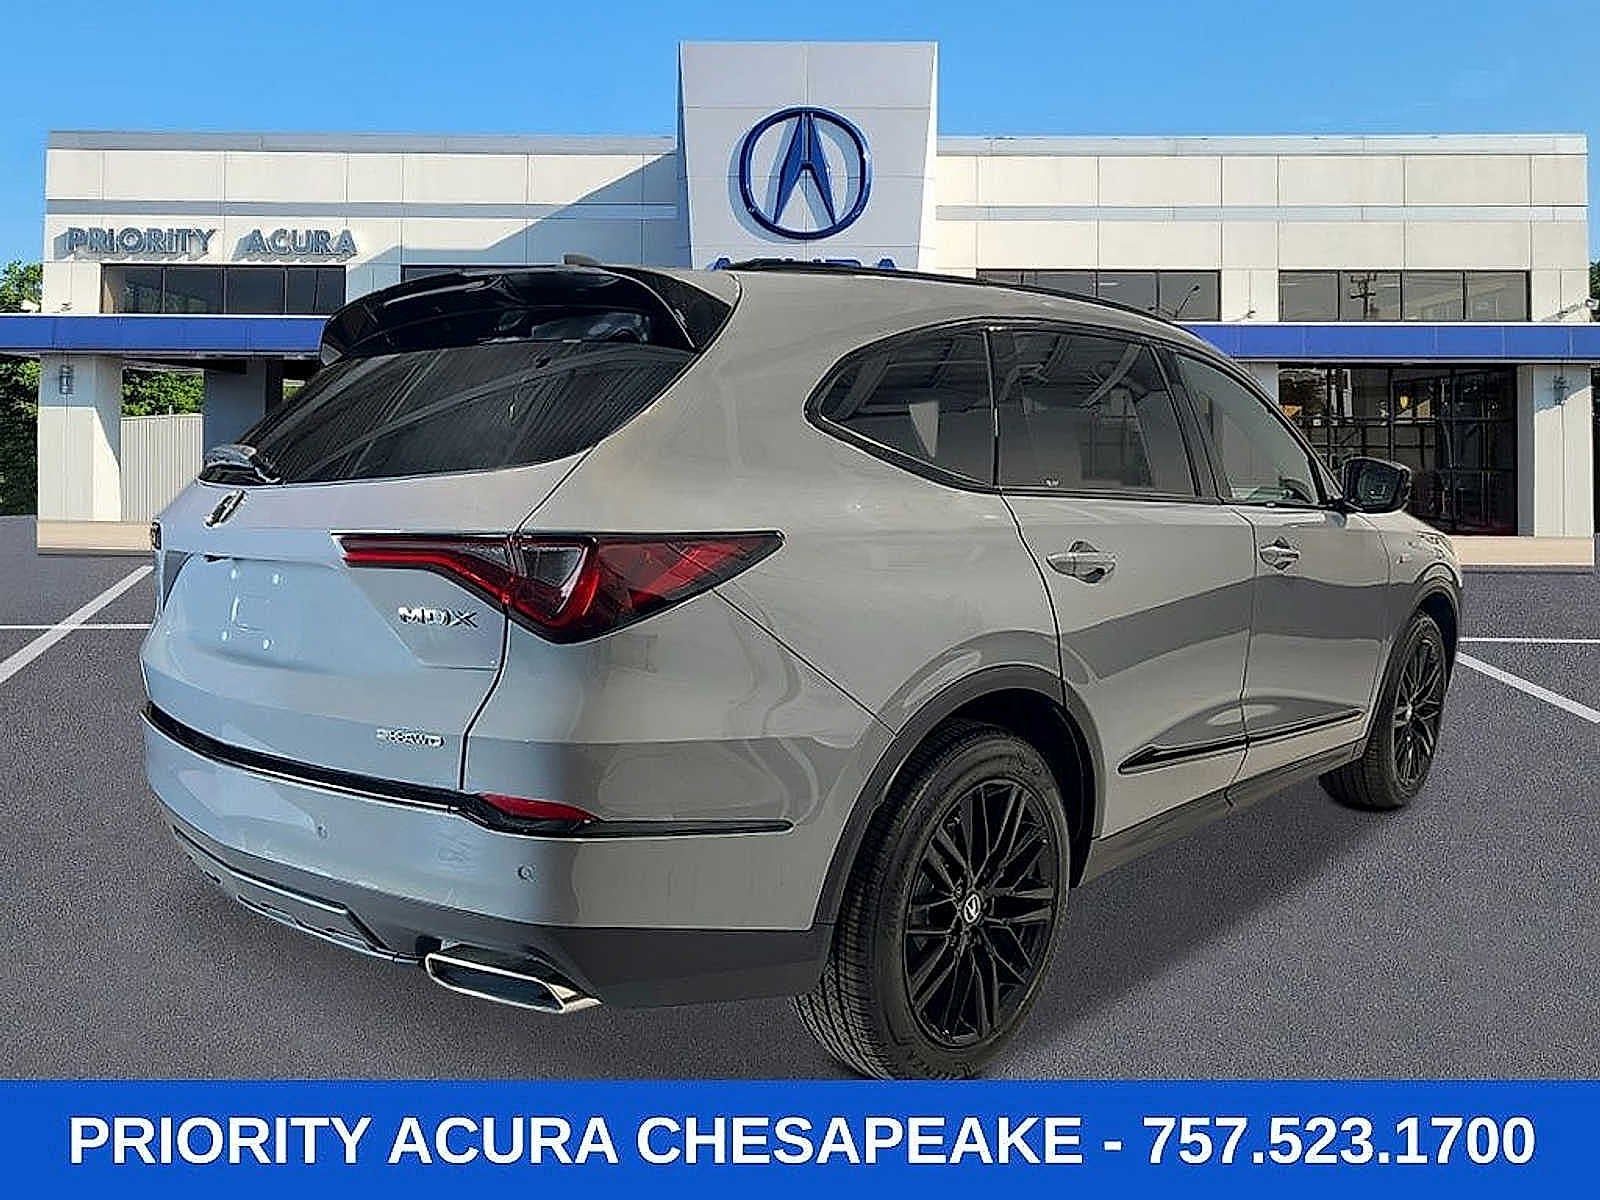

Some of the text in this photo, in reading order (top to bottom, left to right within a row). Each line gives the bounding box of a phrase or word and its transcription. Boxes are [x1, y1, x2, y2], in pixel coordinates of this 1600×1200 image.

[66, 227, 358, 255] PRIORITY ACURA
[398, 607, 478, 628] MDX
